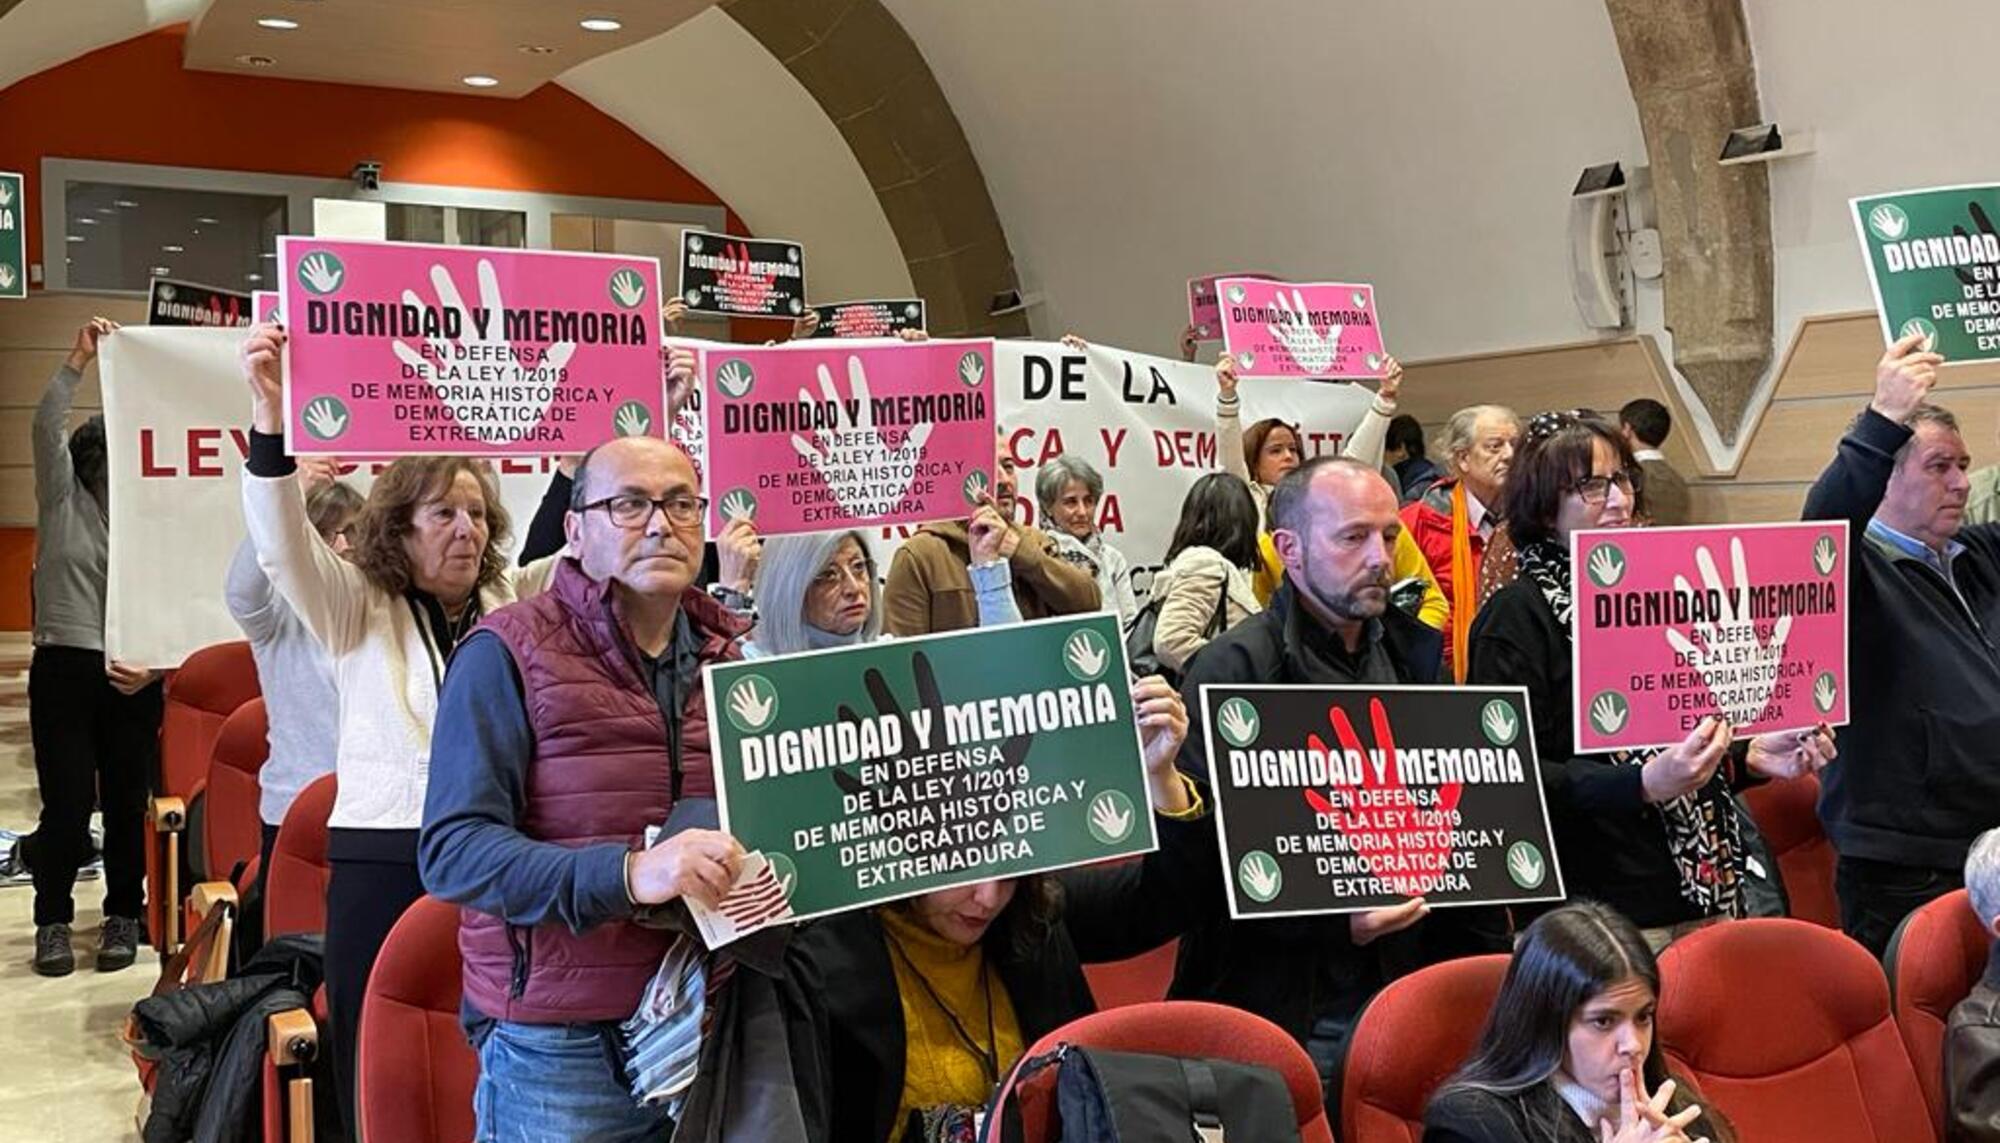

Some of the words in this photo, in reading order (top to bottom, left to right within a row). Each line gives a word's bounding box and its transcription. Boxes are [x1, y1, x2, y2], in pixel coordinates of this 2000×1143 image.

[1883, 234, 1999, 272] DIGNIDAD
[749, 261, 800, 278] MEMORIA
[1973, 267, 1994, 280] EN
[1964, 284, 1985, 298] DE
[307, 300, 463, 339] DIGNIDAD
[475, 308, 490, 340] Y
[503, 309, 647, 345] MEMORIA
[1233, 307, 1292, 325] DIGNIDAD
[1295, 311, 1303, 325] Y
[1309, 311, 1371, 326] MEMORIA
[1931, 303, 1954, 319] DE
[421, 344, 448, 359] EN
[454, 345, 549, 362] DEFENSA
[402, 364, 429, 380] DE
[436, 365, 462, 380] LA
[467, 366, 506, 381] LEY
[513, 367, 568, 383] 1/2019
[1023, 355, 1086, 400] DE
[1123, 360, 1176, 404] LA
[351, 383, 378, 400] DE
[386, 384, 483, 401] MEMORIA
[490, 384, 598, 402] HISTÓRICA
[603, 388, 615, 403] Y
[394, 402, 546, 422] DEMOCRÁTICA
[551, 408, 577, 422] DE
[724, 401, 838, 434] DIGNIDAD
[850, 399, 862, 427] Y
[871, 392, 985, 426] MEMORIA
[409, 426, 565, 442] EXTREMADURA
[812, 435, 830, 448] EN
[834, 431, 911, 447] DEFENSA
[798, 455, 818, 468] DE
[823, 452, 840, 466] LA
[843, 450, 874, 464] LEY
[880, 446, 927, 461] 1/2019
[1009, 427, 1064, 468] CA
[1101, 428, 1127, 468] Y
[1153, 430, 1216, 469] DEM
[759, 474, 781, 488] DE
[787, 470, 857, 487] MEMORIA
[862, 462, 951, 481] HISTÓRICA
[955, 461, 965, 473] Y
[792, 484, 909, 505] DEMOCRÁTICA
[913, 481, 934, 494] DE
[803, 500, 925, 523] EXTREMADURA
[1594, 589, 1721, 628] DIGNIDAD
[1728, 587, 1740, 620] Y
[1750, 581, 1836, 619] MEMORIA
[1690, 629, 1711, 645] EN
[1716, 624, 1777, 643] DEFENSA
[1674, 652, 1697, 668] DE
[1702, 649, 1722, 665] LA
[1726, 647, 1749, 664] LEY
[1754, 644, 1787, 661] 1/2019
[1630, 675, 1655, 691] DE
[1661, 669, 1738, 690] MEMORIA
[1740, 662, 1804, 684] HISTÓRICA
[1806, 660, 1815, 674] Y
[1668, 686, 1772, 710] DEMOCRÁTICA
[1775, 684, 1791, 699] DE
[739, 713, 903, 782] DIGNIDAD
[910, 707, 933, 751] Y
[943, 682, 1117, 746] MEMORIA
[860, 762, 890, 787] EN
[895, 745, 1006, 782] DEFENSA
[1229, 750, 1364, 787] DIGNIDAD
[1369, 749, 1386, 784] Y
[1398, 748, 1524, 785] MEMORIA
[843, 792, 873, 816] DE
[878, 787, 908, 809] LA
[911, 777, 957, 805] LEY
[962, 764, 1030, 795] 1/2019
[1329, 791, 1354, 808] EN
[1360, 788, 1443, 806] DEFENSA
[794, 827, 825, 852] DE
[830, 806, 936, 846] MEMORIA
[939, 784, 1068, 824] HISTÓRICA
[1071, 779, 1087, 800] Y
[1316, 812, 1342, 831] DE
[1346, 812, 1369, 830] LA
[1374, 811, 1408, 829] LEY
[1412, 809, 1462, 828] 1/2019
[840, 820, 1008, 868] DEMOCRÁTICA
[1014, 811, 1046, 835] DE
[1276, 835, 1303, 854] DE
[1307, 833, 1396, 853] MEMORIA
[1399, 829, 1489, 850] HISTÓRICA
[1492, 829, 1505, 846] Y
[856, 840, 1034, 890] EXTREMADURA
[1316, 853, 1450, 876] DEMOCRÁTICA
[1453, 852, 1477, 869] DE
[1332, 873, 1471, 897] EXTREMADURA
